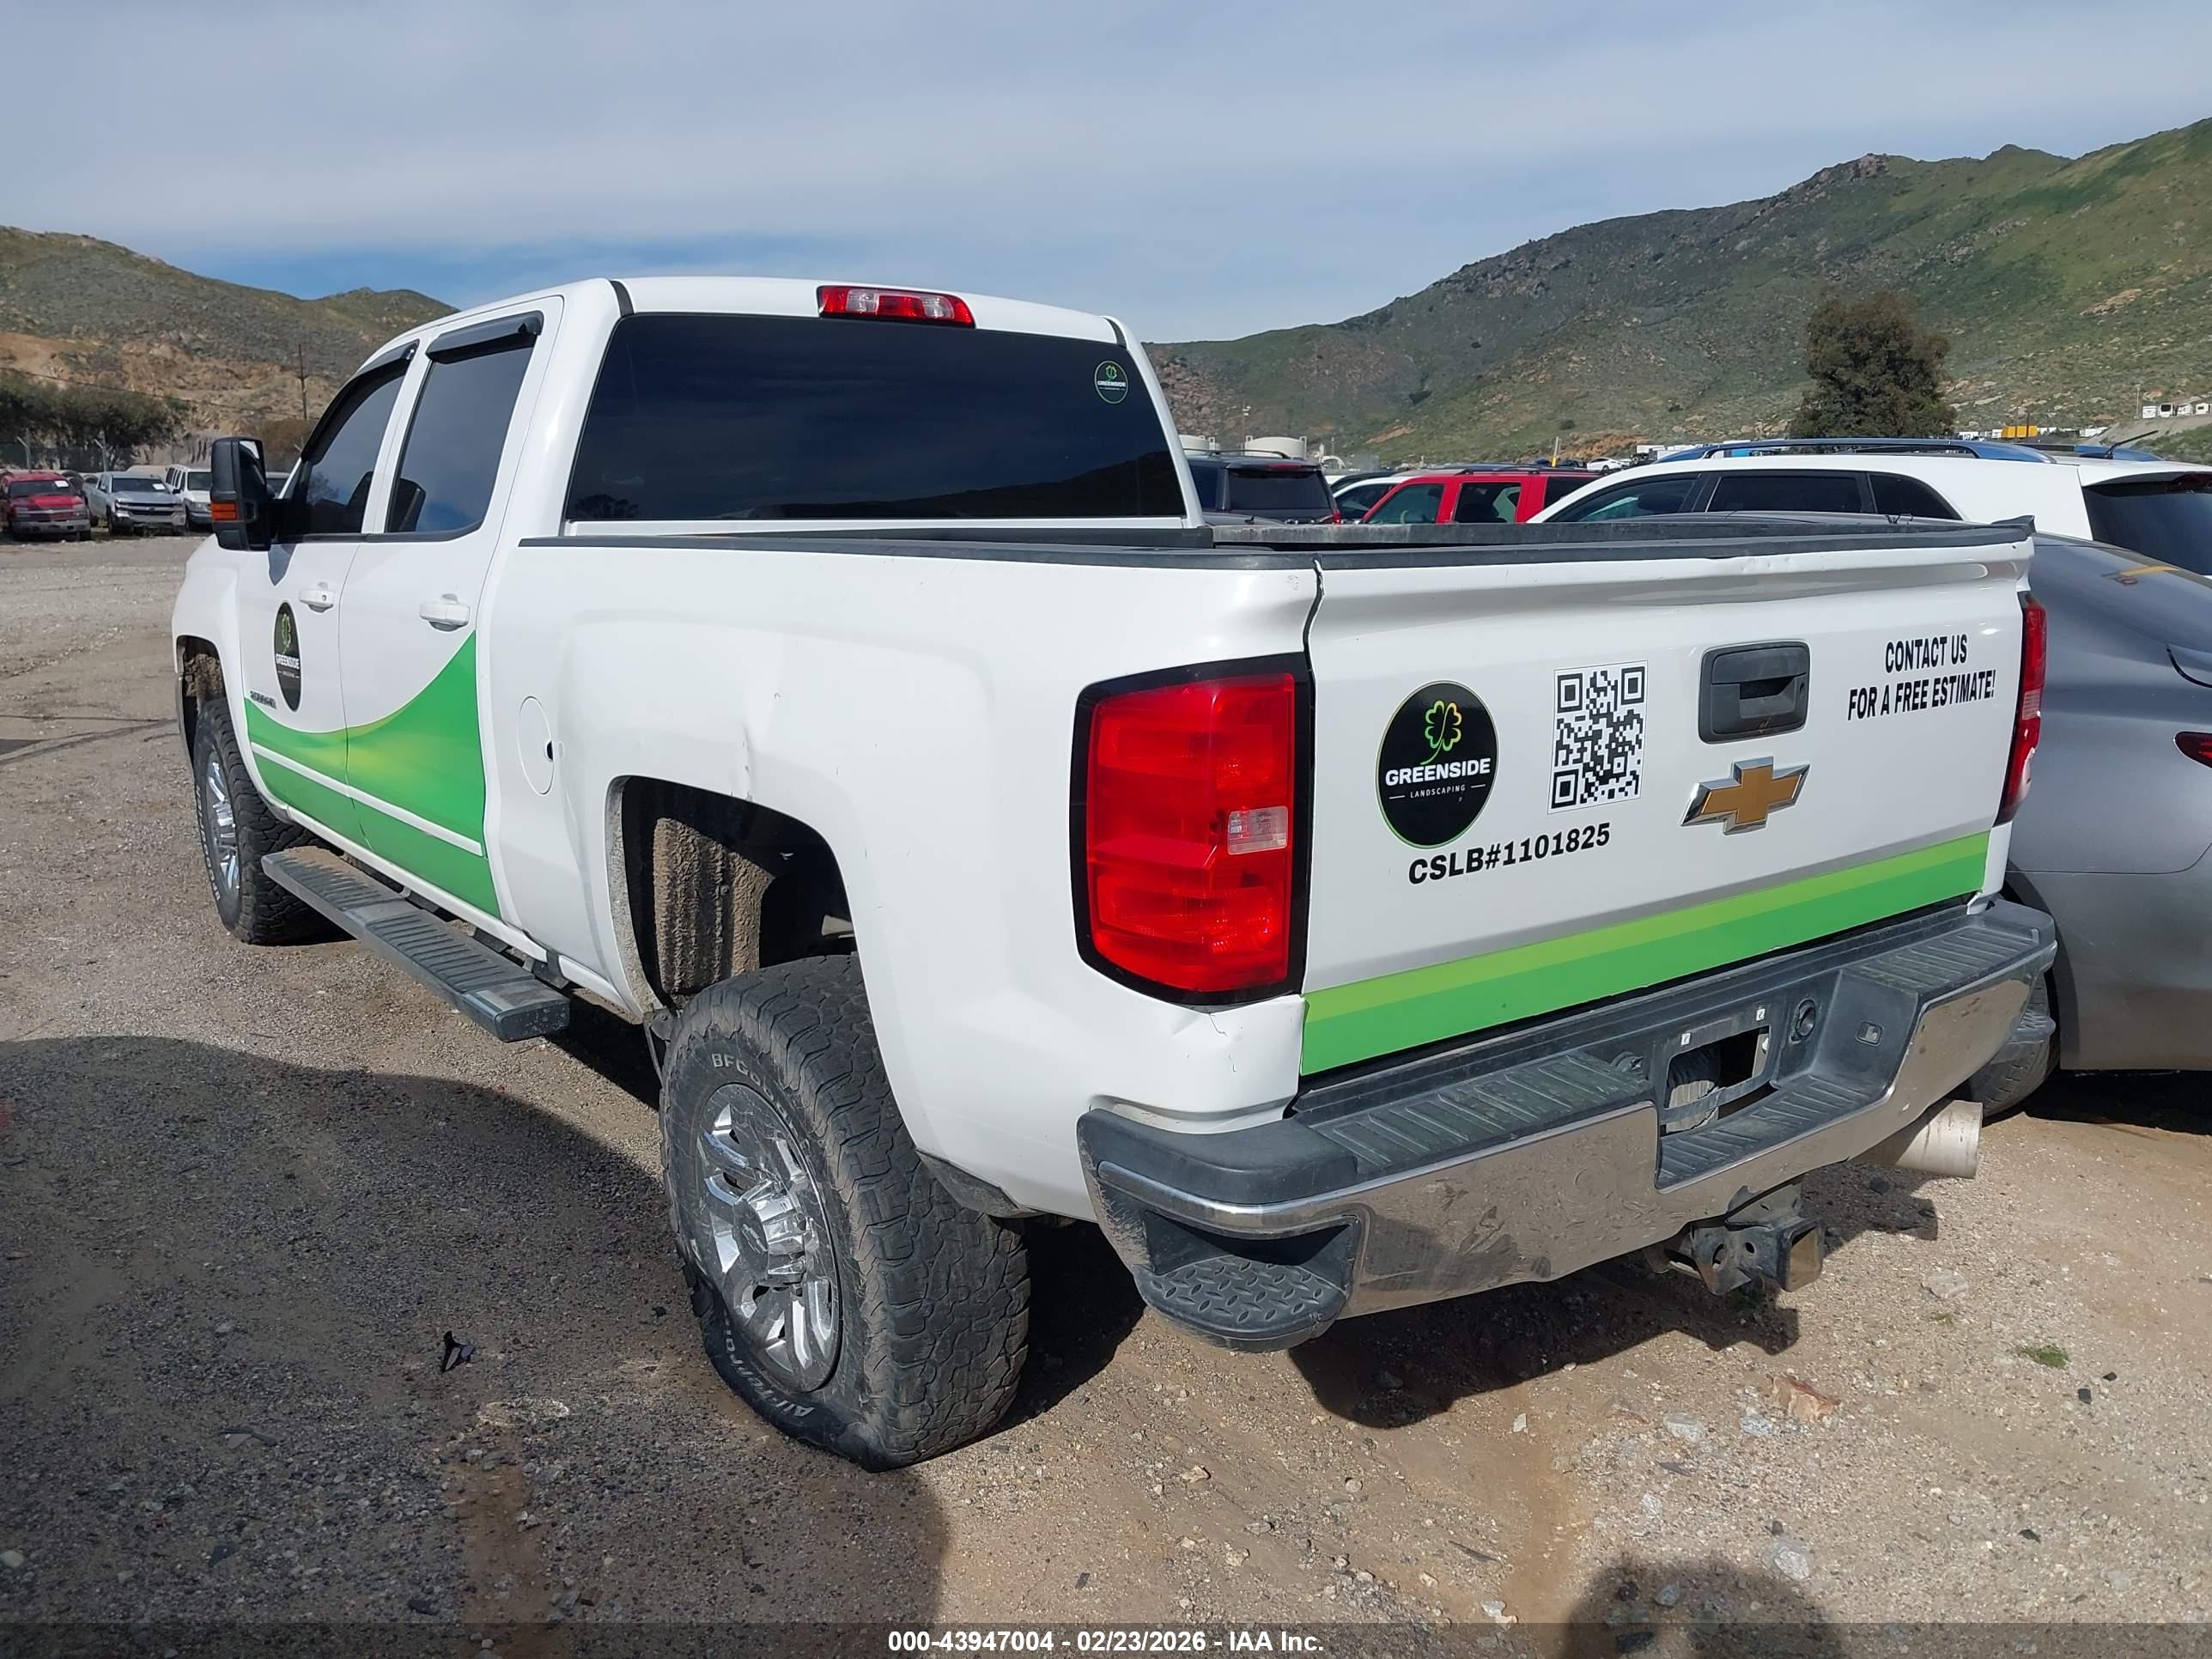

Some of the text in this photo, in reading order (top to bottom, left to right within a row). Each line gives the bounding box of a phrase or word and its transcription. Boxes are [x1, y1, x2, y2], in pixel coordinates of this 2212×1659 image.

[1885, 634, 1967, 673] CONTACT US
[1848, 669, 1996, 720] FOR A FREE ESTIMATE!
[1385, 757, 1492, 786] GREENSIDE
[1410, 784, 1466, 799] LANDSCAPING
[1408, 822, 1610, 884] CSLB#1101825
